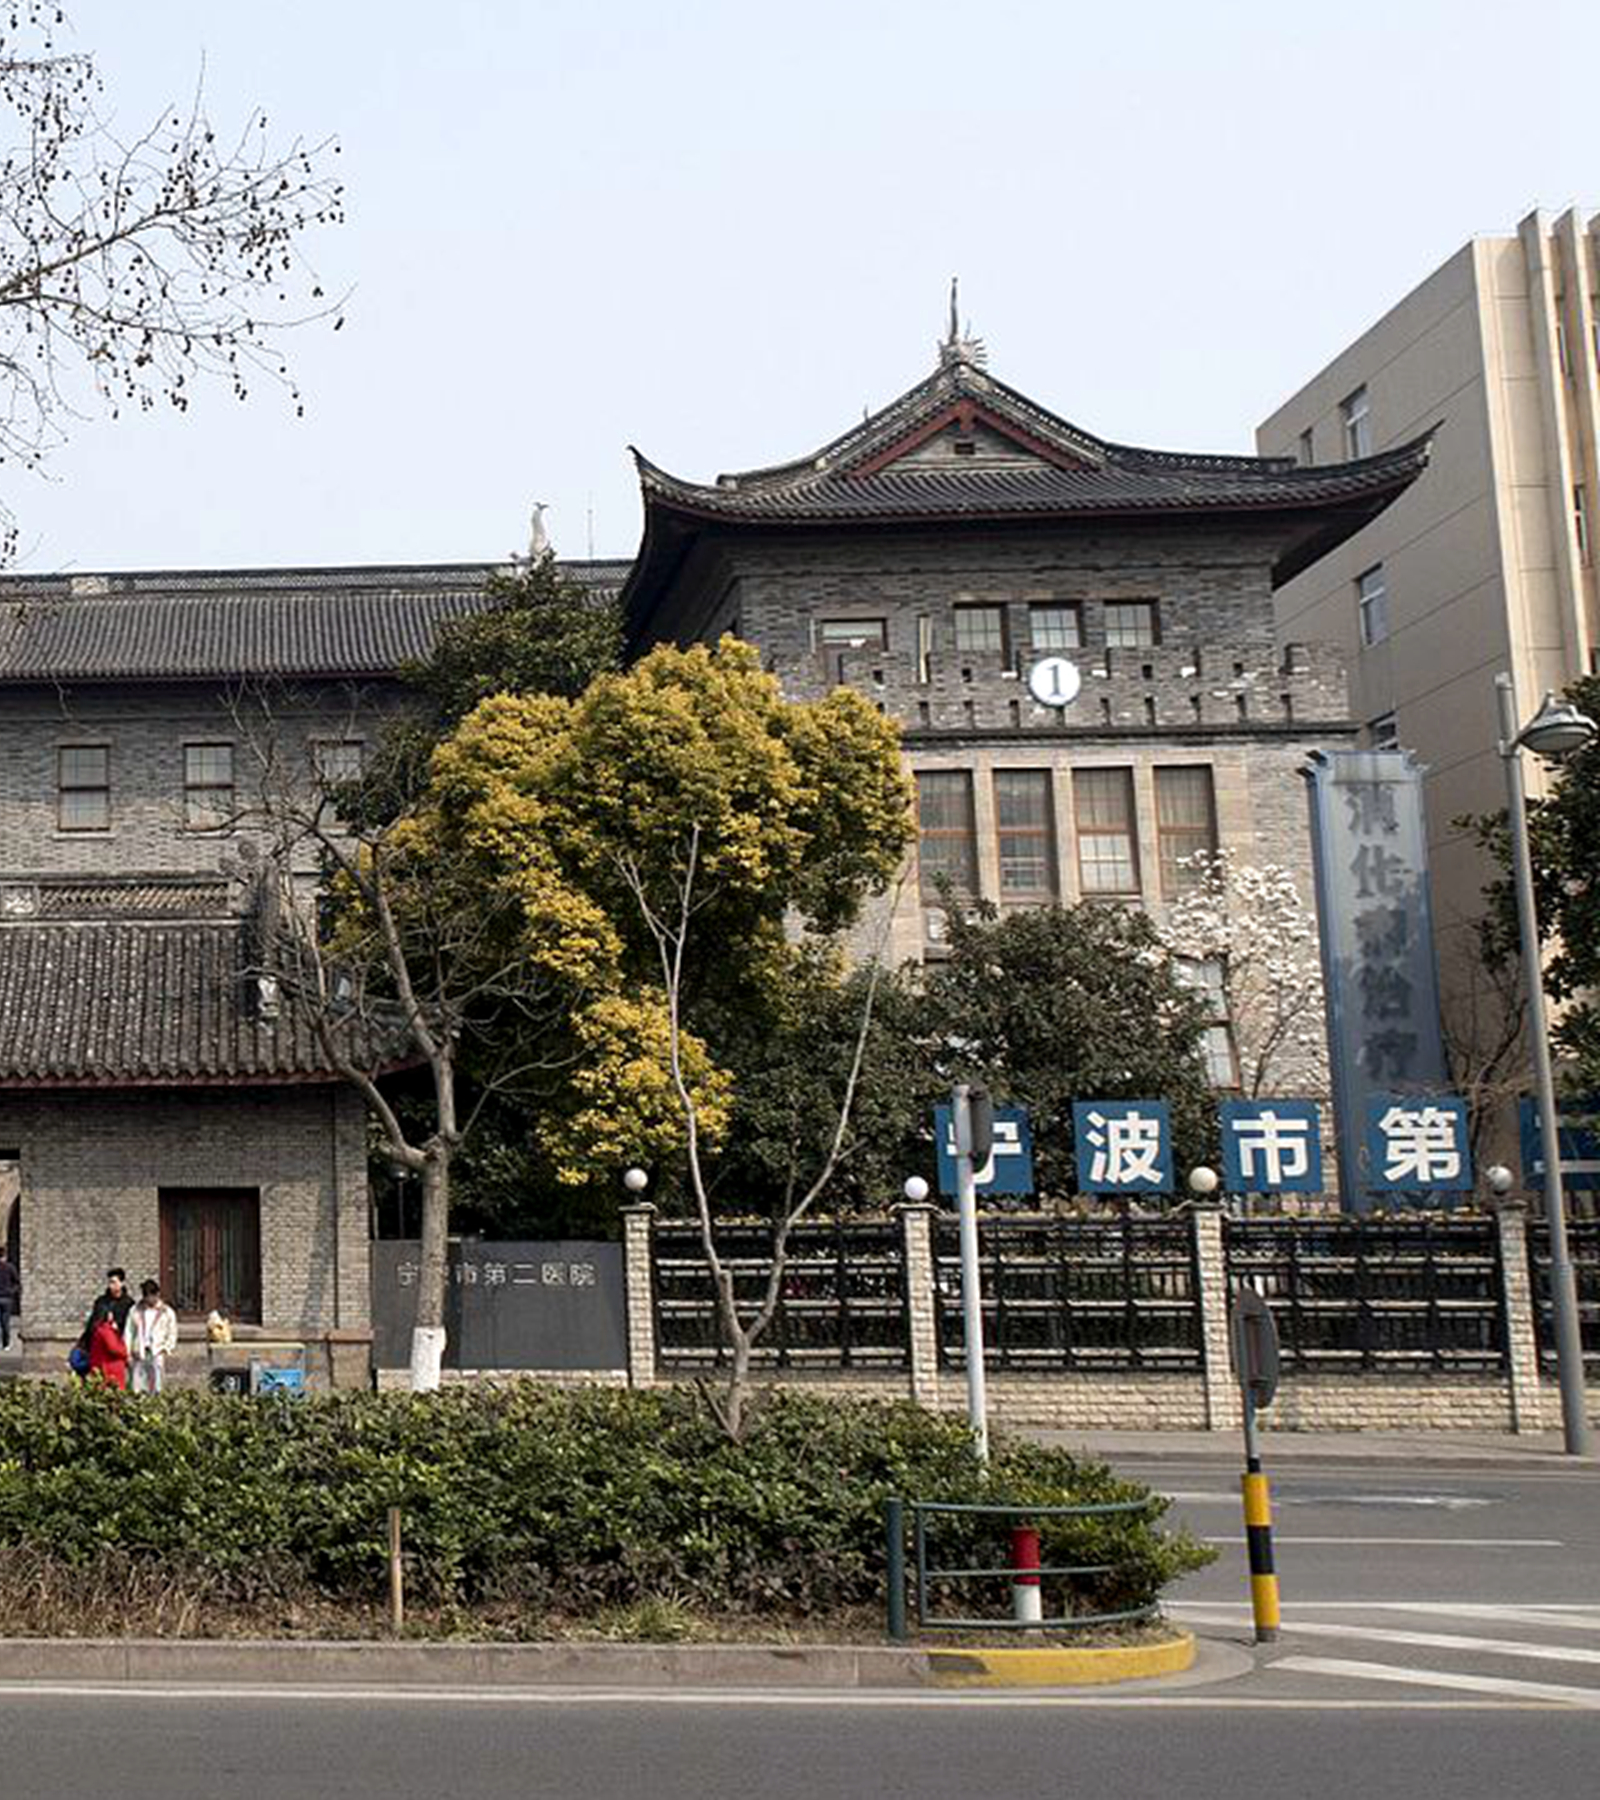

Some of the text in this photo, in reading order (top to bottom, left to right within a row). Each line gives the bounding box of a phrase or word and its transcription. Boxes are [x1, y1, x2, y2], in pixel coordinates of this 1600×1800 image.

[1046, 663, 1067, 698] 1
[397, 1260, 596, 1287] 宁市第二医院
